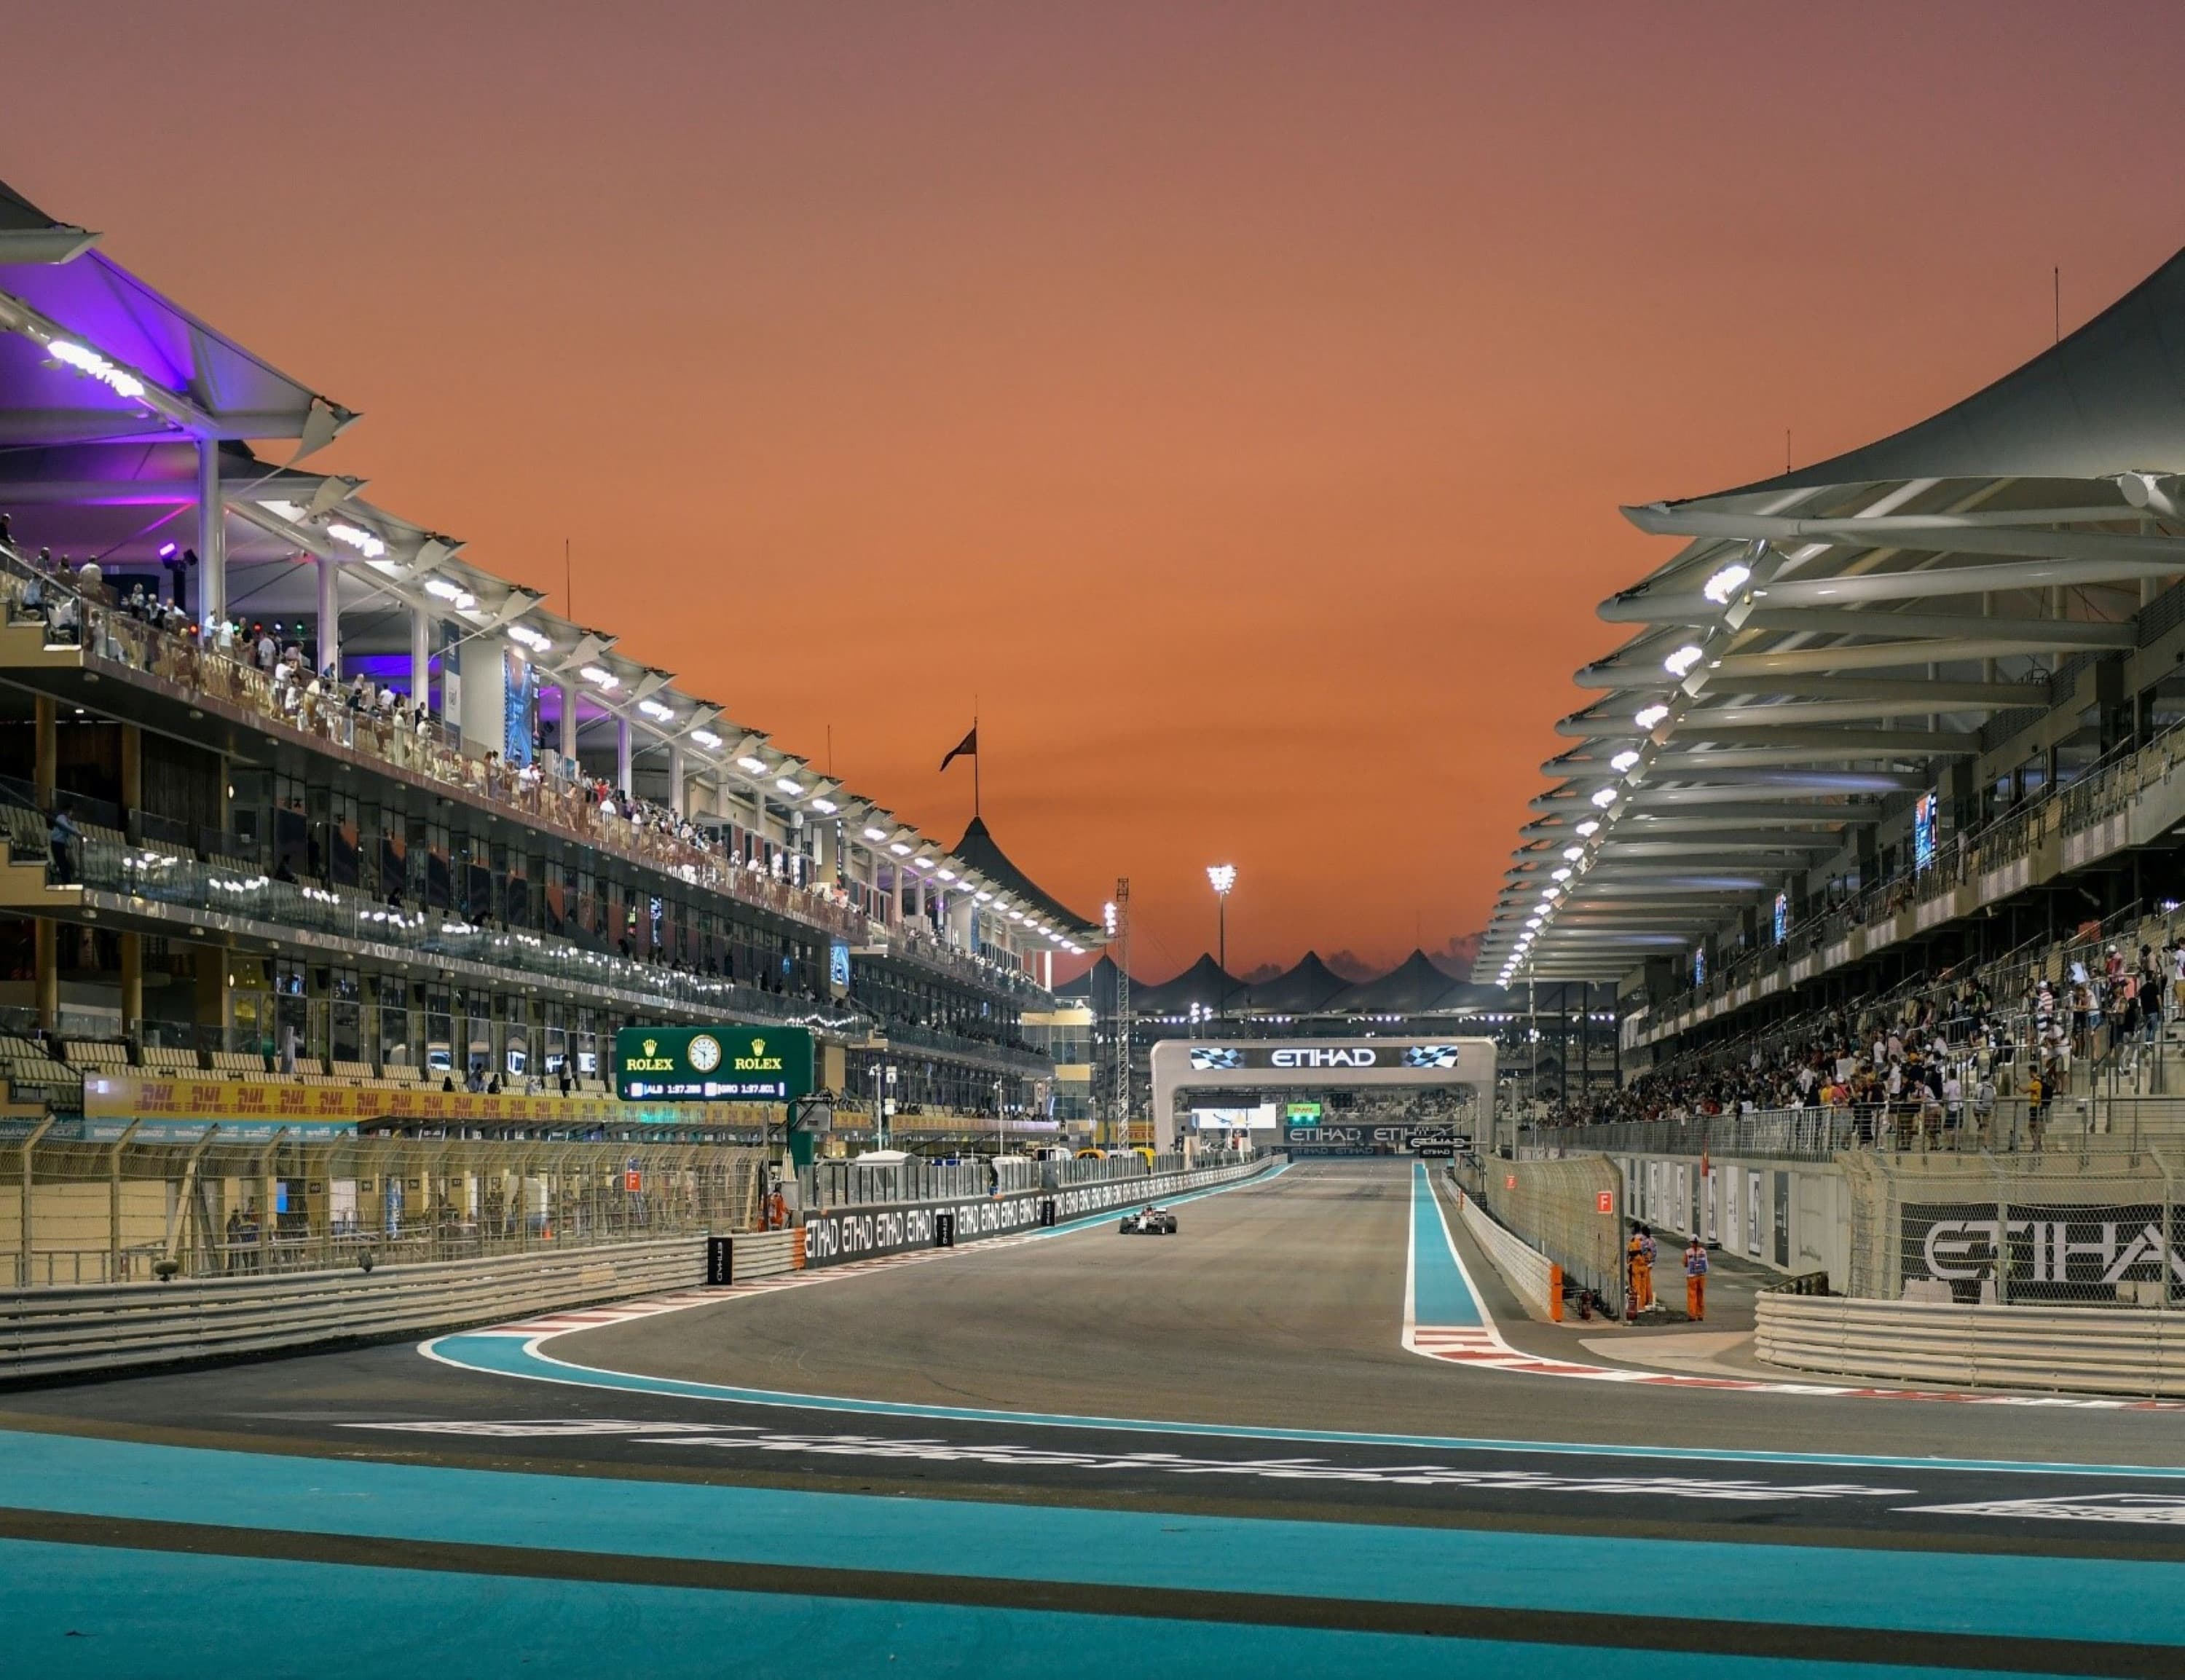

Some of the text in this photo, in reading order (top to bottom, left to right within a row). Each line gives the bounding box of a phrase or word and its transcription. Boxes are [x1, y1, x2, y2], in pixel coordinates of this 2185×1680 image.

[626, 1059, 674, 1071] ROLEX
[735, 1058, 782, 1070] ROLEX
[1272, 1049, 1376, 1066] ETIHAD
[141, 1084, 175, 1112] DHL
[192, 1086, 221, 1113] DHL
[237, 1088, 266, 1113] DHL
[280, 1089, 306, 1114] DHL
[319, 1092, 343, 1114] DHL
[1289, 1128, 1361, 1141] ETIHAD
[629, 1174, 637, 1188] F
[1601, 1195, 1608, 1210] F
[804, 1218, 838, 1258] ETIHAD
[842, 1215, 873, 1252] ETIHAD
[876, 1212, 904, 1247] ETIHAD
[907, 1209, 931, 1242] ETIHAD
[959, 1205, 979, 1234] ETIHAD
[629, 1437, 1843, 1500] ENERGY FOR LIFE
